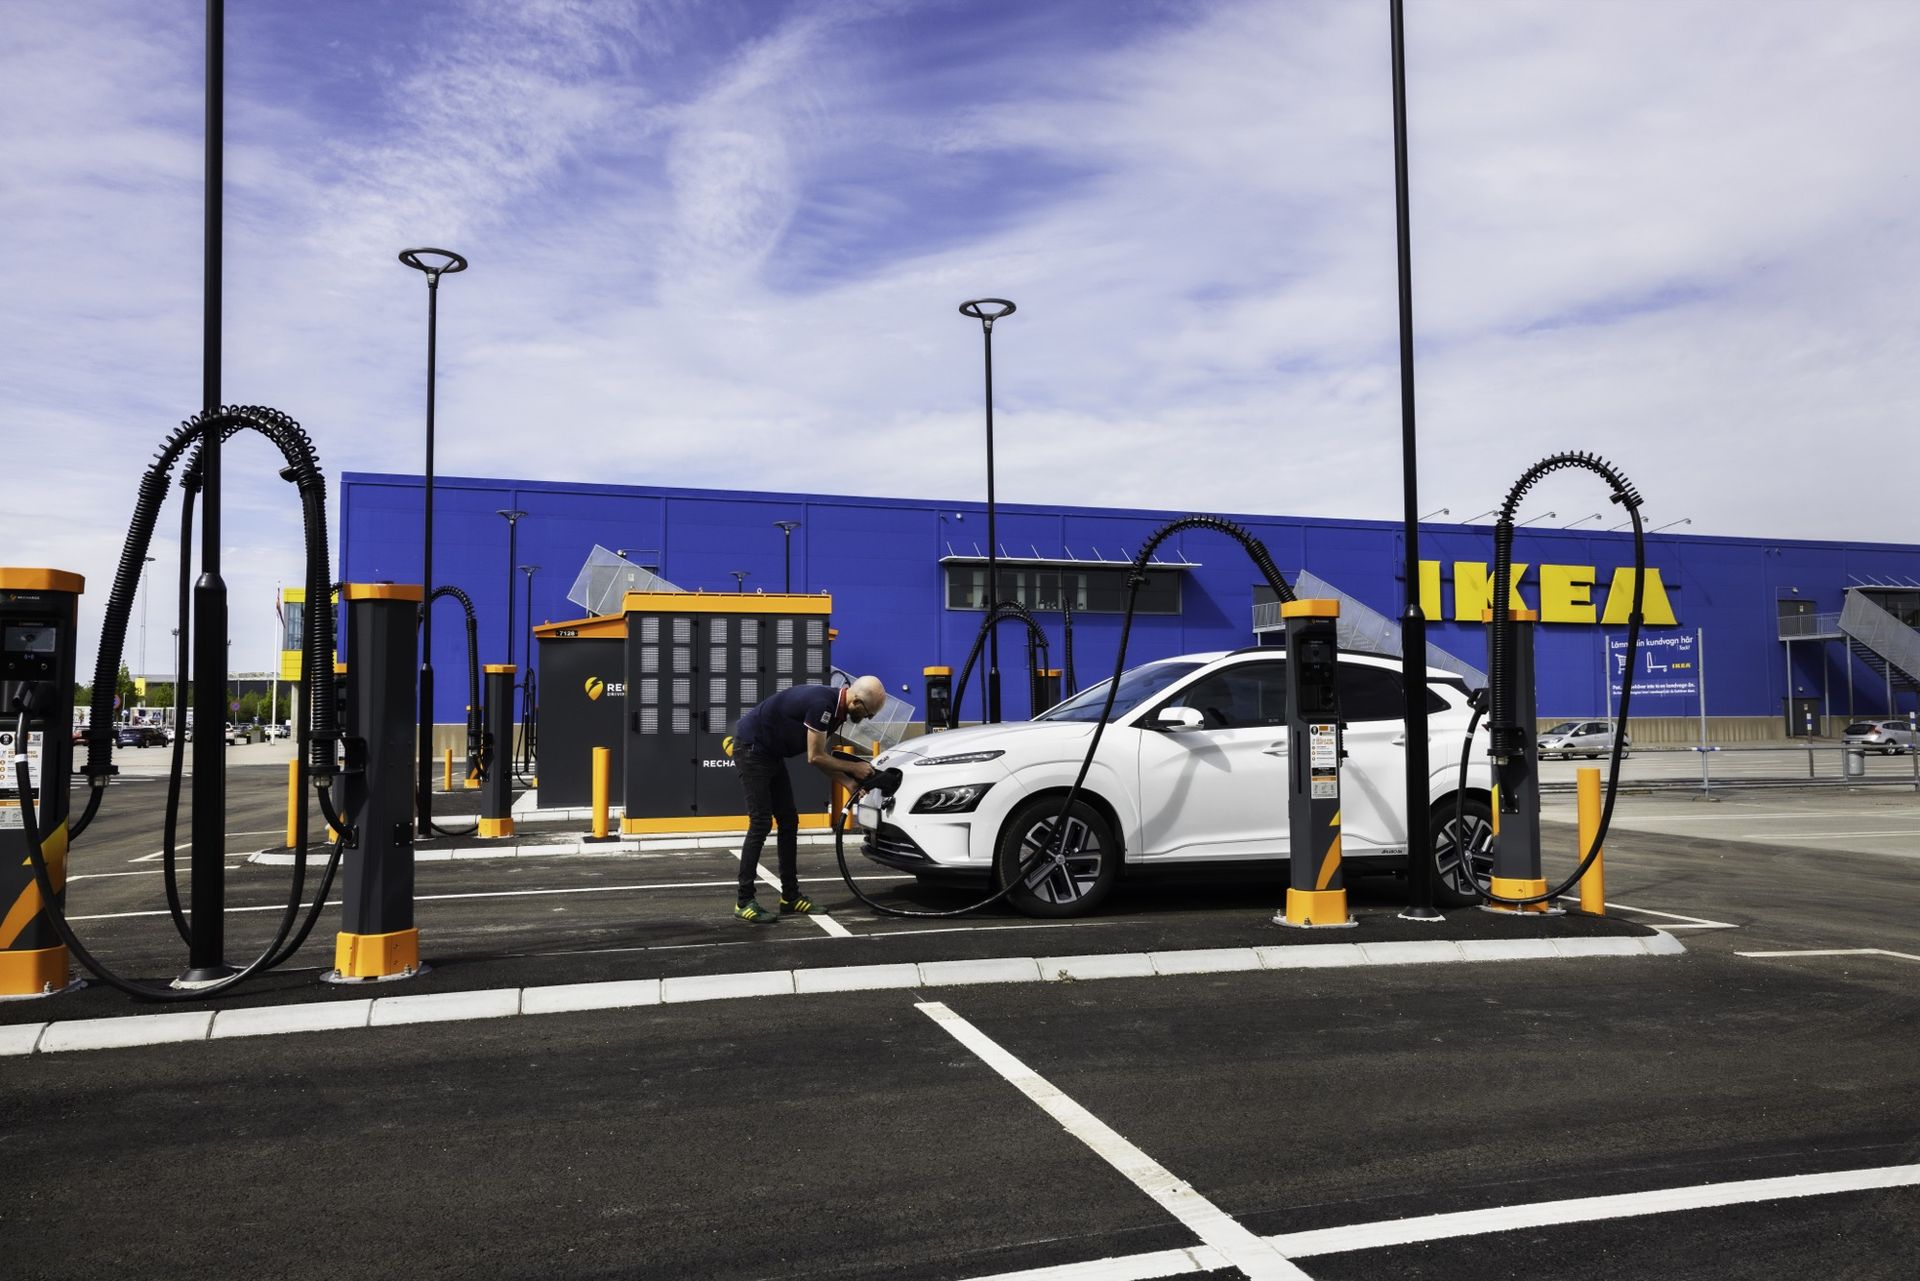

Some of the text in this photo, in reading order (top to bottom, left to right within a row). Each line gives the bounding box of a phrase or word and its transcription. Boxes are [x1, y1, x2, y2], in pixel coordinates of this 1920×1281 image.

[1417, 560, 1679, 625] IKEA
[1611, 641, 1629, 649] Lämn
[1646, 637, 1679, 646] kundvagn
[1681, 635, 1693, 643] här
[703, 759, 737, 768] RECHA
